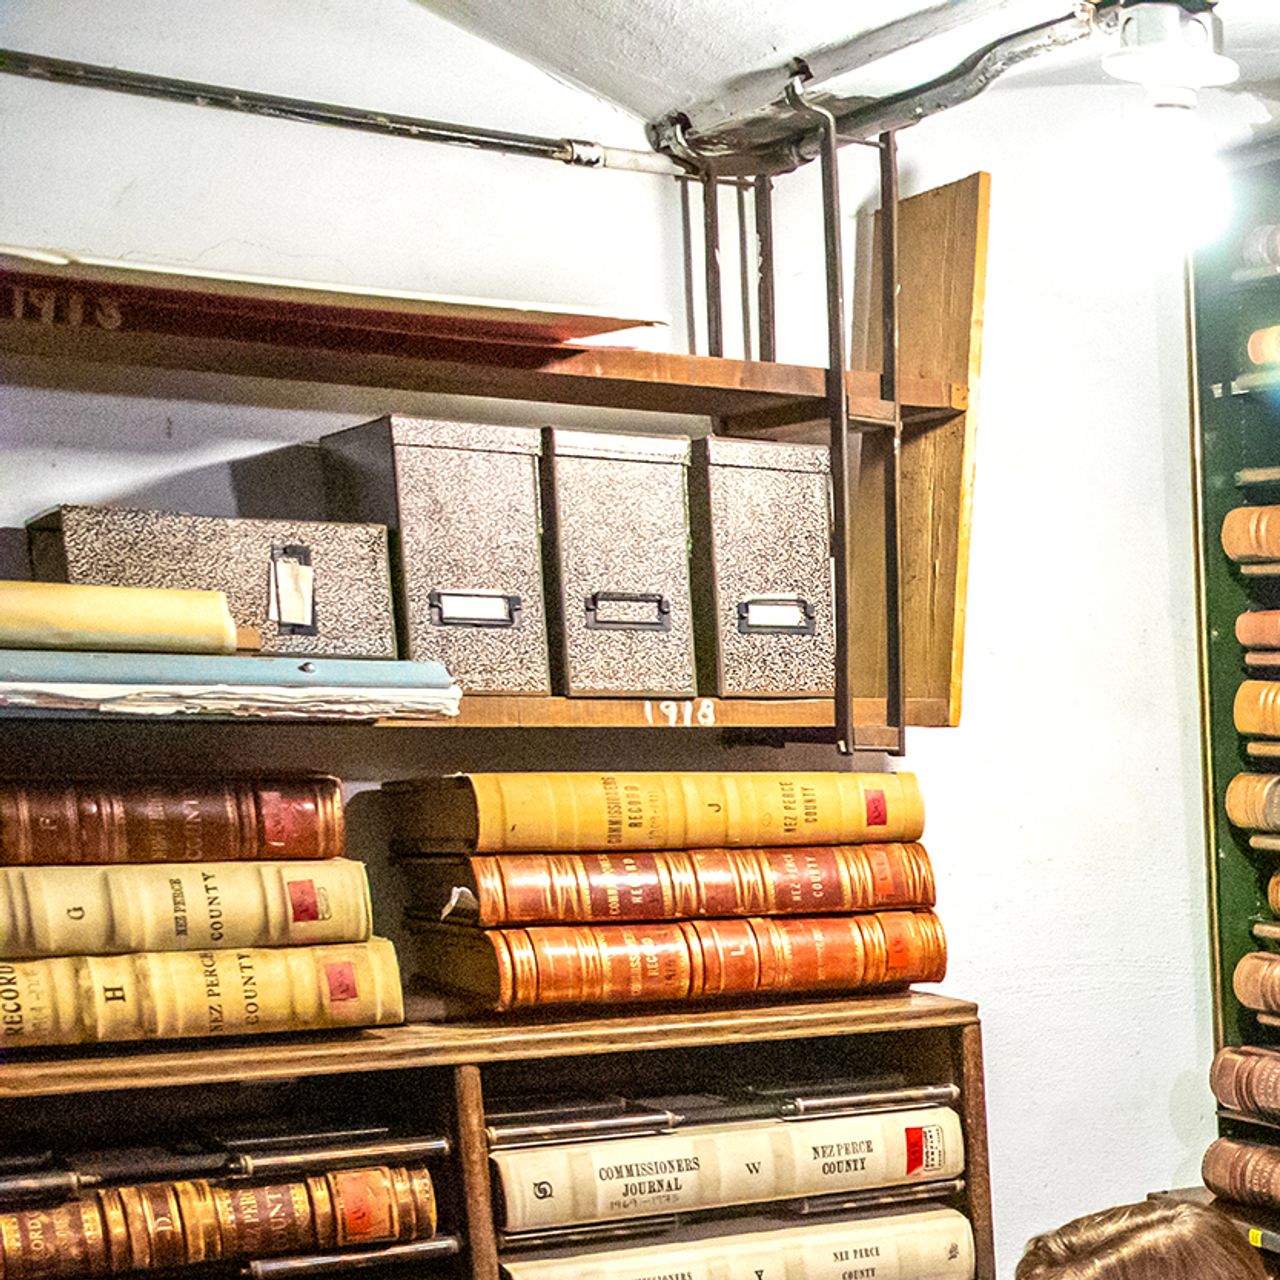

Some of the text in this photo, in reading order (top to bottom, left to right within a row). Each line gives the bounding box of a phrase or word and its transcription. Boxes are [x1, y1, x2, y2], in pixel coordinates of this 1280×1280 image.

[644, 701, 716, 727] 1918
[624, 785, 641, 829] RECORD
[707, 803, 722, 813] J
[783, 781, 797, 834] NEZ PERCE
[802, 786, 817, 823] COUNTY
[803, 857, 824, 898] COUNTY
[66, 905, 85, 920] G
[171, 878, 188, 936] NEZ PERCE
[202, 872, 223, 940] COUNTY
[1, 964, 23, 1037] RECORD
[105, 985, 126, 1003] H
[238, 952, 259, 1024] COUNTY
[812, 1140, 873, 1160] NEZ PERCE
[599, 1156, 701, 1182] COMMISSIONERS
[745, 1161, 762, 1176] W
[821, 1157, 867, 1175] COUNTY
[621, 1178, 682, 1197] JOURNAL
[833, 1247, 880, 1262] NEZ PERCE
[842, 1267, 876, 1280] COUNTY
